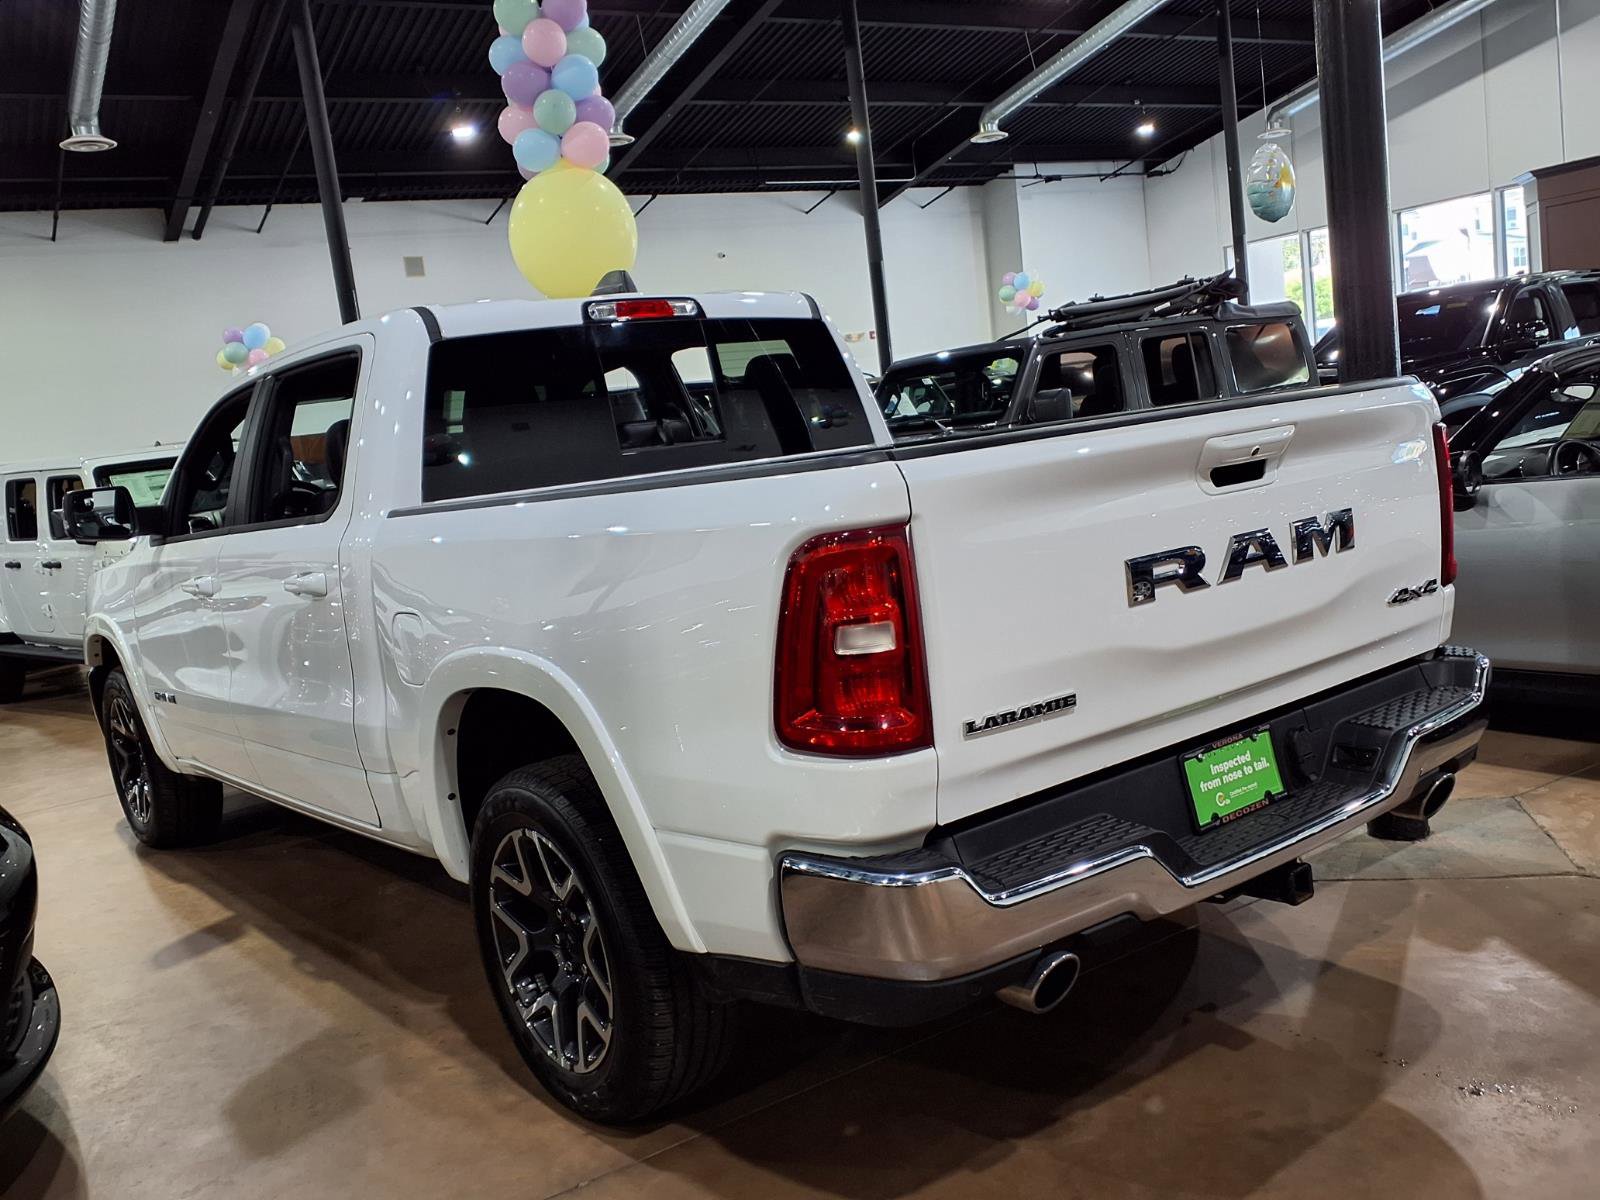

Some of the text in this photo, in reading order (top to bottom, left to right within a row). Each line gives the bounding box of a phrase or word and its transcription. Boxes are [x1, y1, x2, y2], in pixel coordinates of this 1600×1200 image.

[1123, 507, 1355, 608] RAM
[963, 692, 1077, 737] LARAMIE
[1212, 733, 1244, 749] VERONA
[1200, 777, 1222, 792] from
[1223, 769, 1243, 783] nose
[1243, 764, 1253, 775] to
[1253, 757, 1270, 771] tail.
[1210, 750, 1251, 775] Inspected
[1222, 799, 1269, 823] DECOZEN
